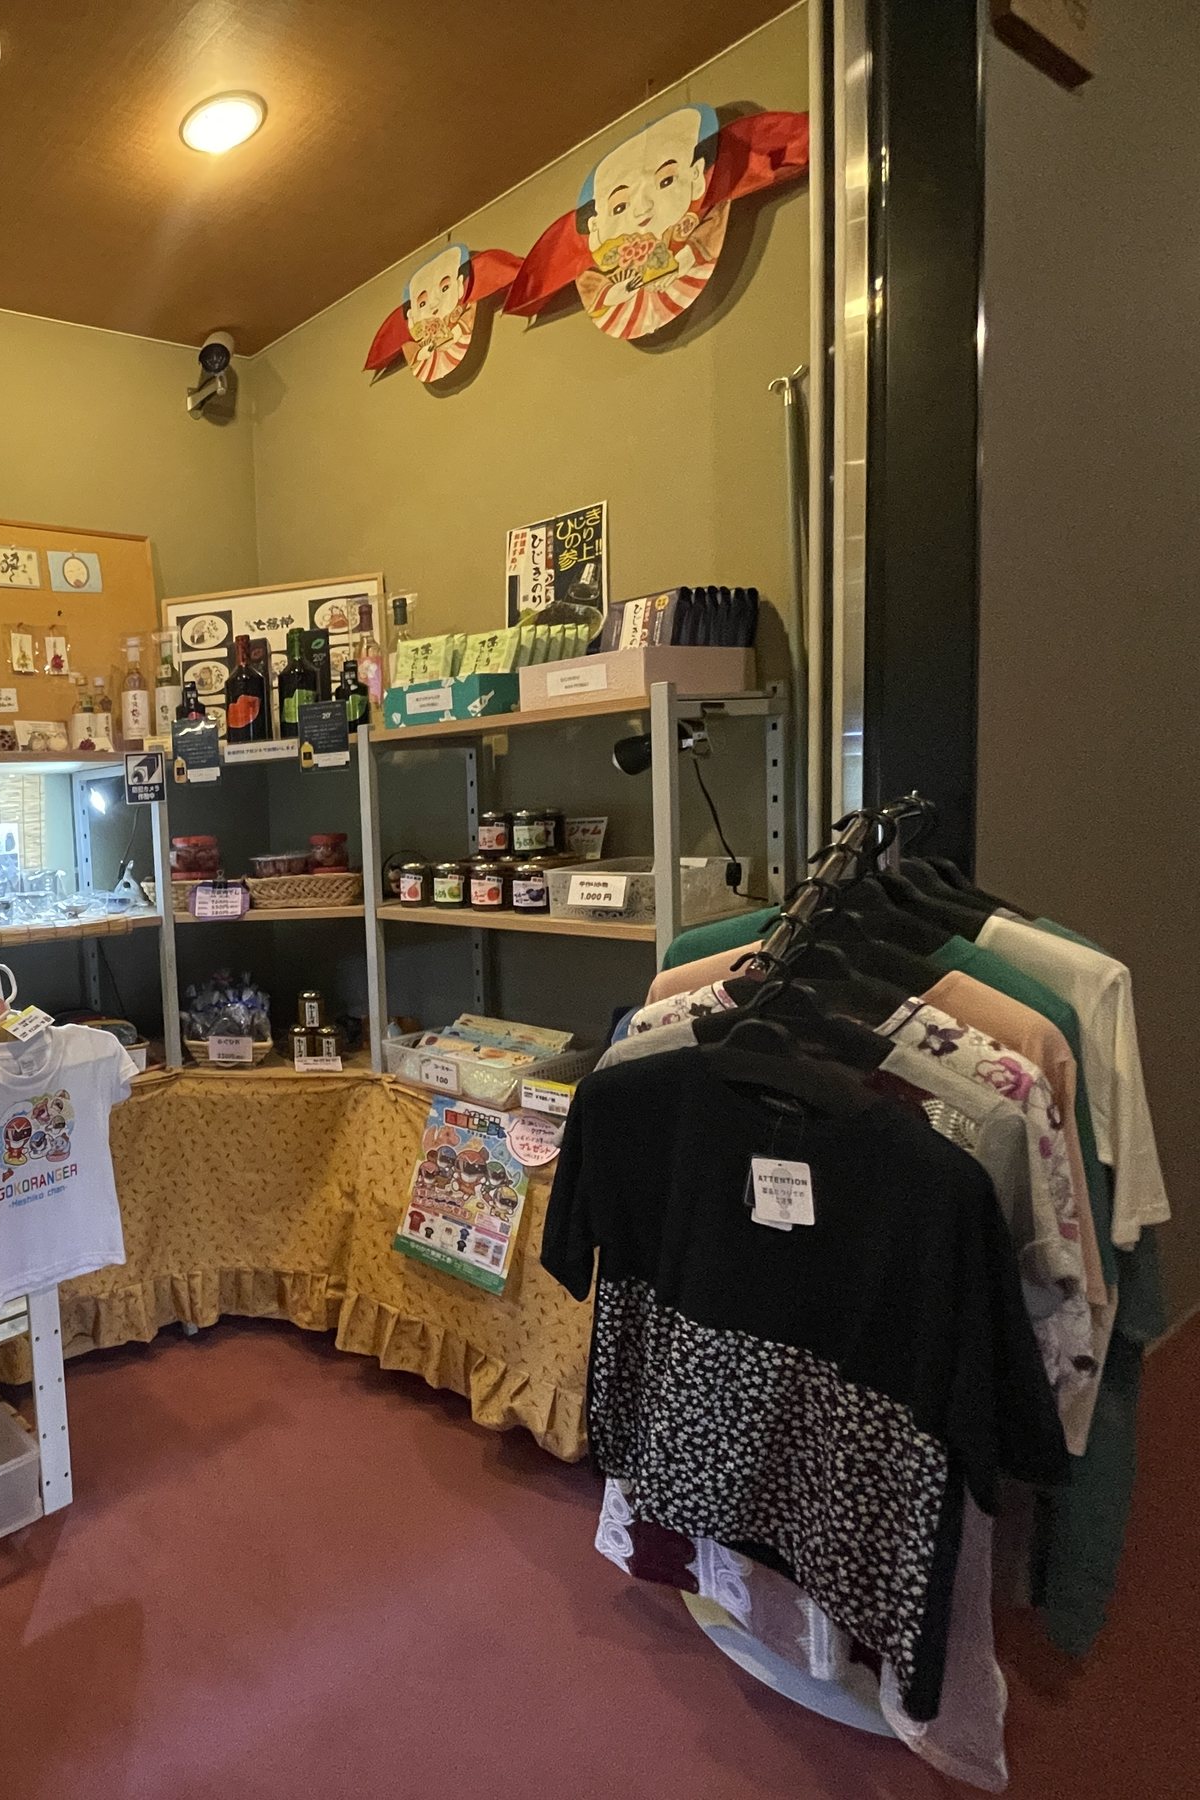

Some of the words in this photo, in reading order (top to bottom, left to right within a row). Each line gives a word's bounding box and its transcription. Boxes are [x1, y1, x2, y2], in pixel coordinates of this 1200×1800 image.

[530, 533, 544, 608] ひじきのり
[519, 1142, 551, 1155] プレゼント
[758, 1174, 808, 1187] ATTENTION
